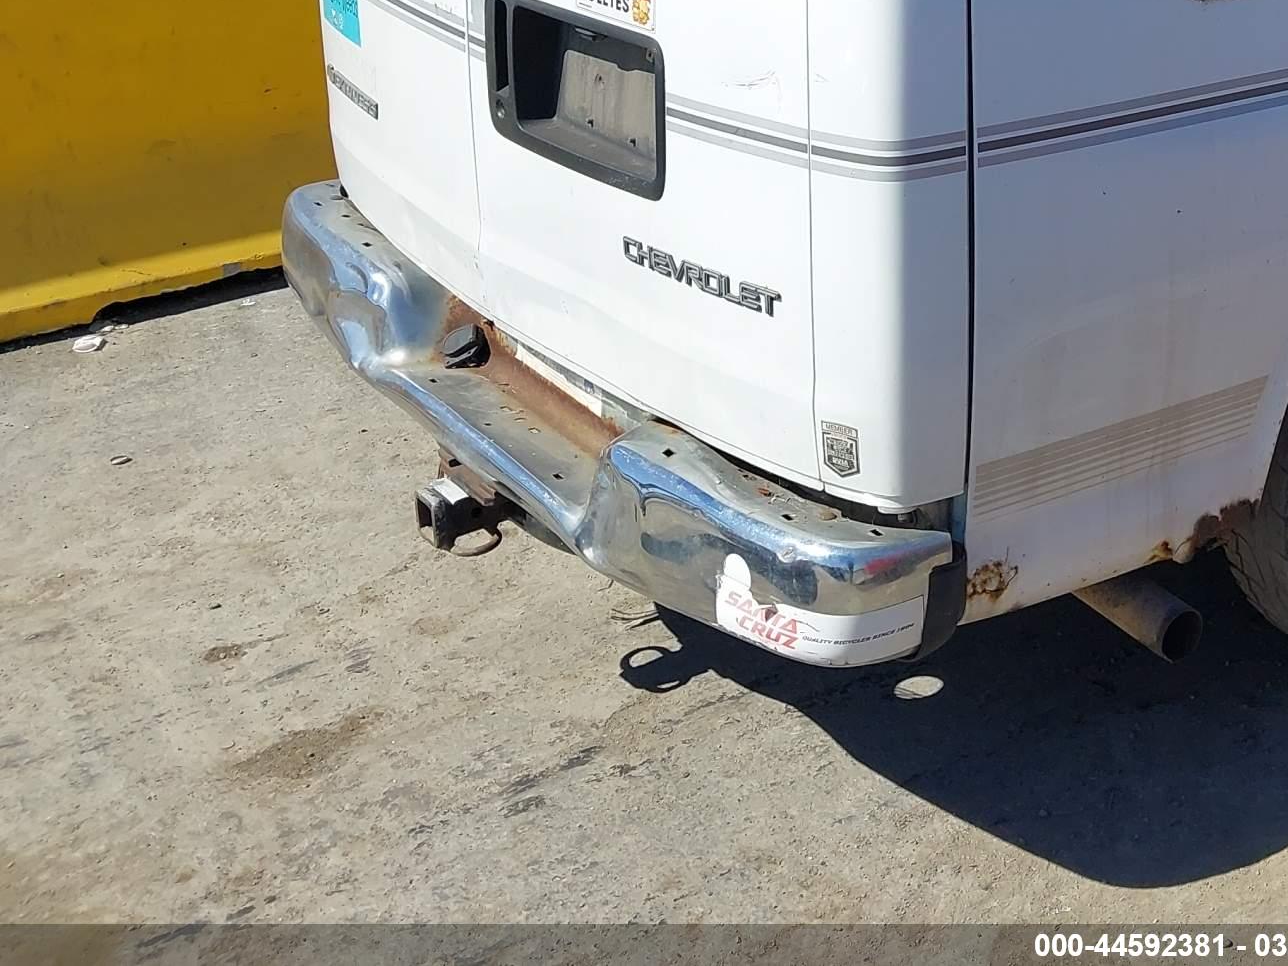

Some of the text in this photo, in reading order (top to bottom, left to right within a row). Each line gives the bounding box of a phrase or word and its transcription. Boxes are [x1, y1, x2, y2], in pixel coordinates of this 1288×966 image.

[623, 235, 782, 317] CHEVROLET
[739, 615, 799, 649] CRUZ
[802, 635, 833, 645] QUALITY
[833, 636, 871, 645] BICYCLES
[872, 629, 896, 641] SINCE
